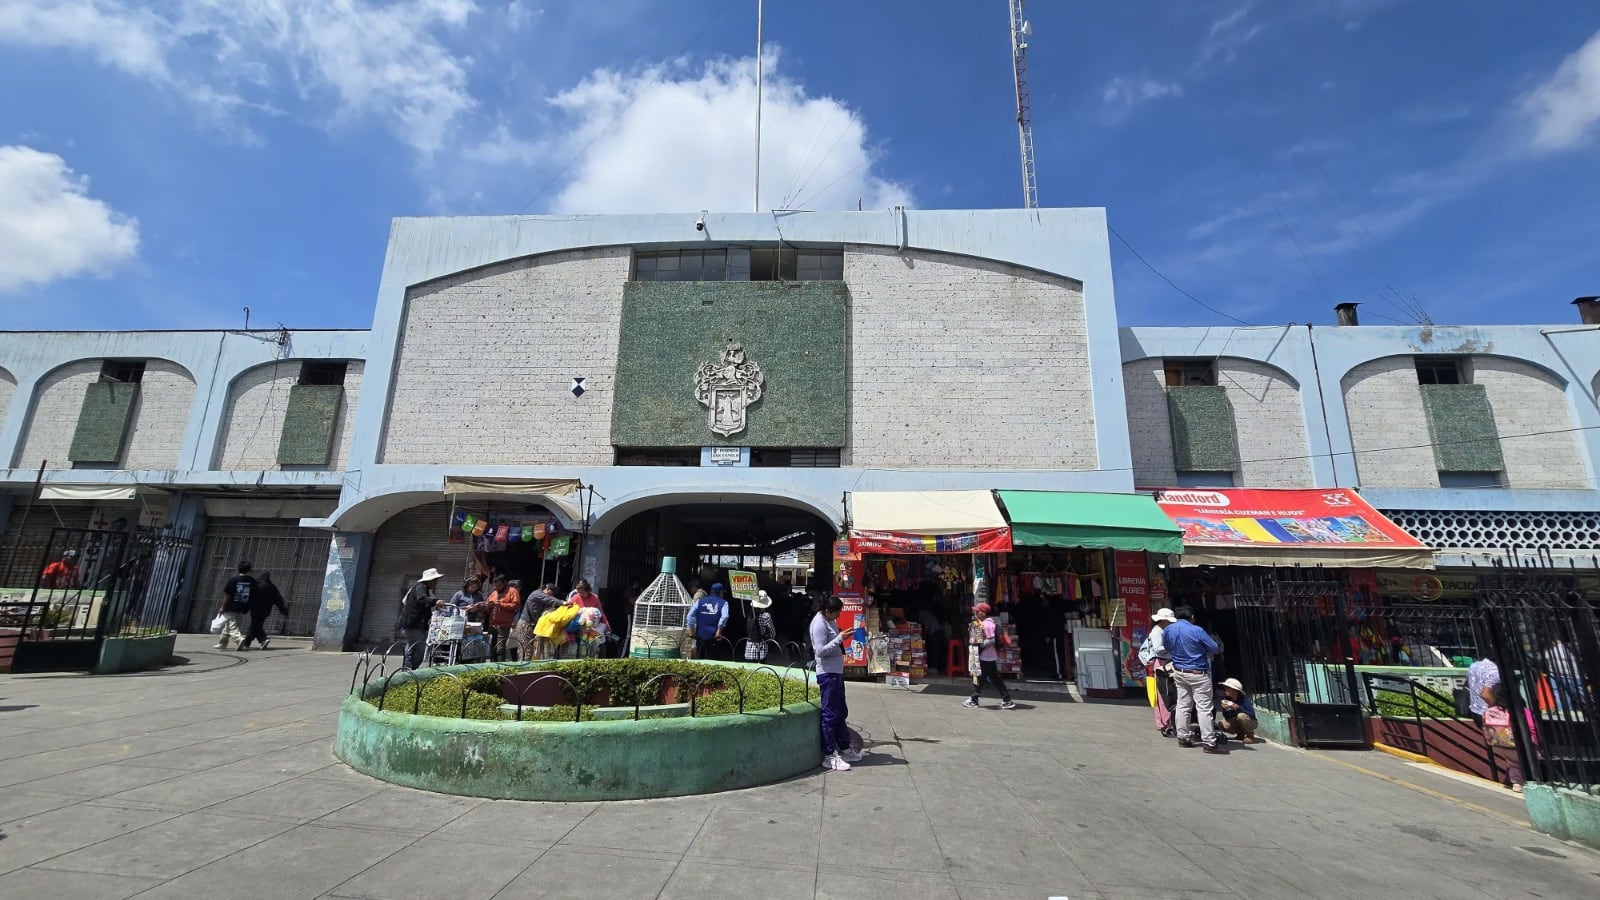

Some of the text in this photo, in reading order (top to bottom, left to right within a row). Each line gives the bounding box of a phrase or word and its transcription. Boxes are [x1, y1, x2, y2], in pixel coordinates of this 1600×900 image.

[731, 575, 753, 583] VENTA
[731, 583, 739, 591] DE
[1121, 586, 1146, 595] FLORES
